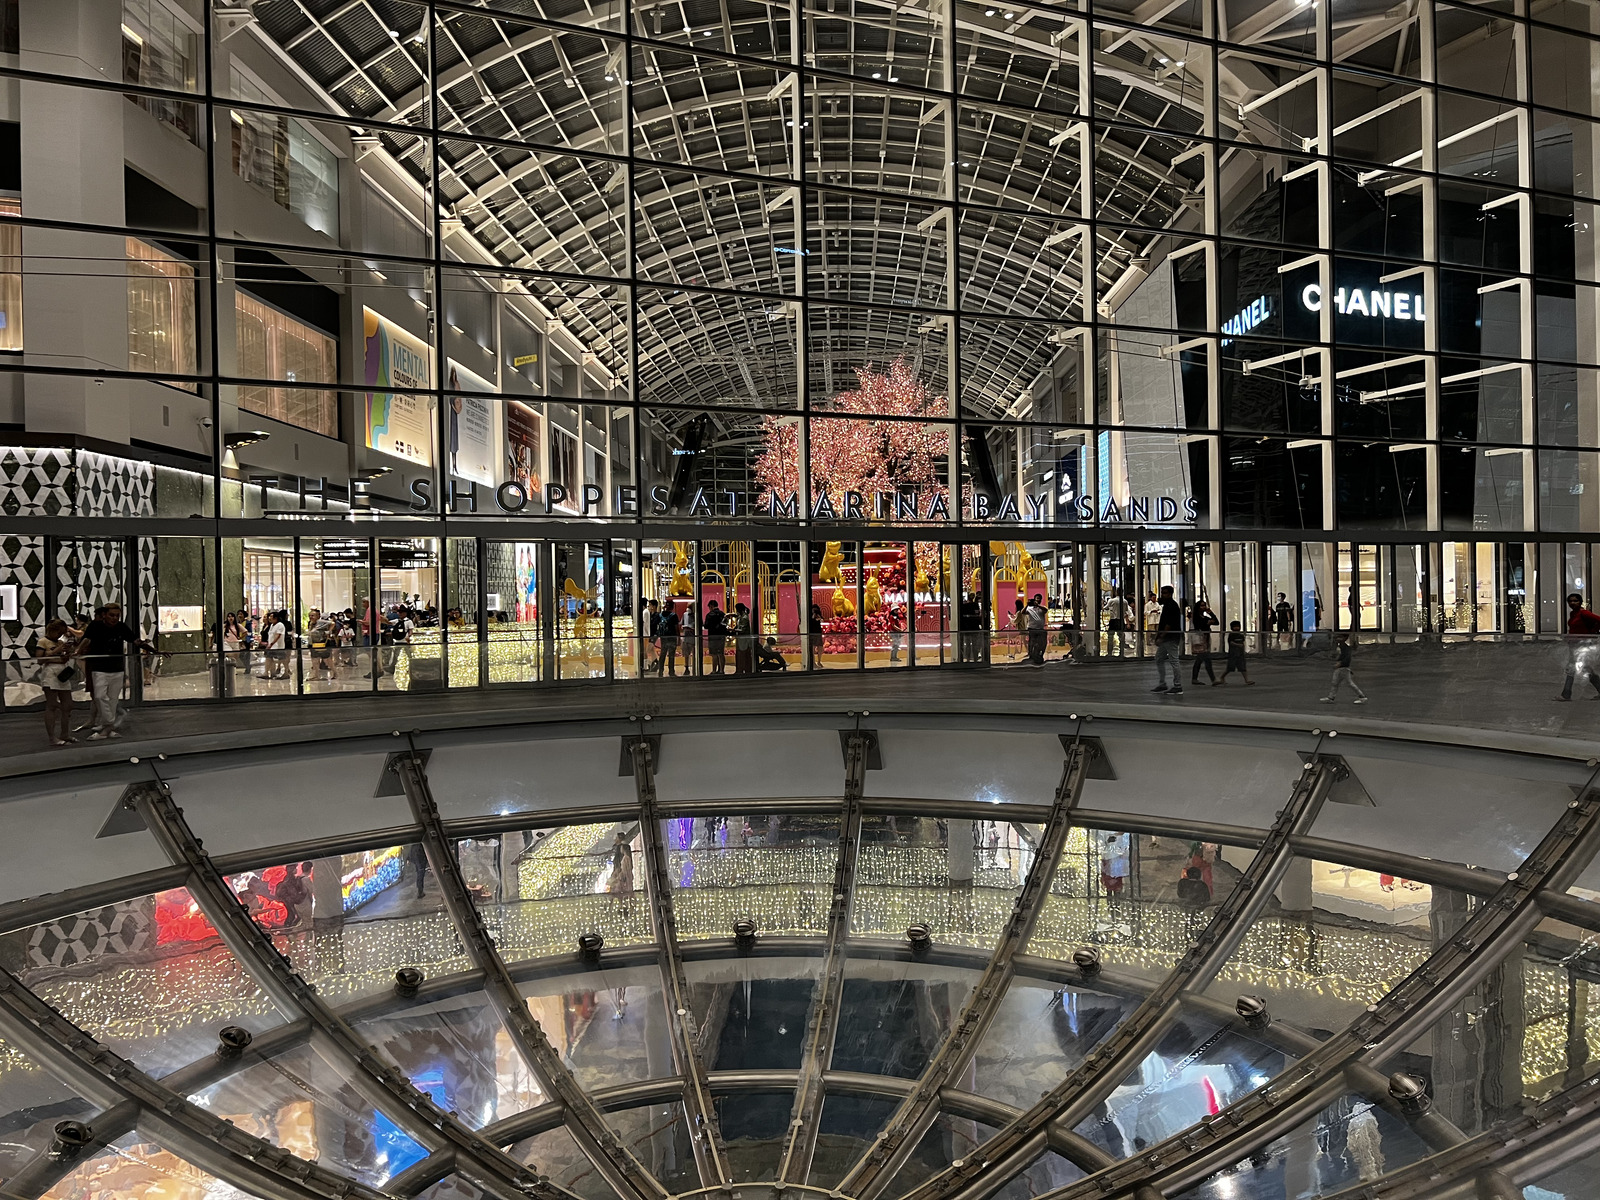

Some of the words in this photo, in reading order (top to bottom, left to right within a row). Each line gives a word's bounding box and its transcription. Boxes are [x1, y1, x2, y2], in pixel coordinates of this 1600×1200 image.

[1302, 284, 1427, 321] CHANEL
[393, 343, 428, 384] MENTAL
[394, 369, 412, 387] COLOURS
[249, 475, 371, 510] THE
[410, 479, 670, 516] SHOPPES
[689, 486, 747, 517] AT
[770, 489, 951, 519] MARINA
[972, 493, 1048, 520] BAY
[1075, 494, 1199, 523] SANDS
